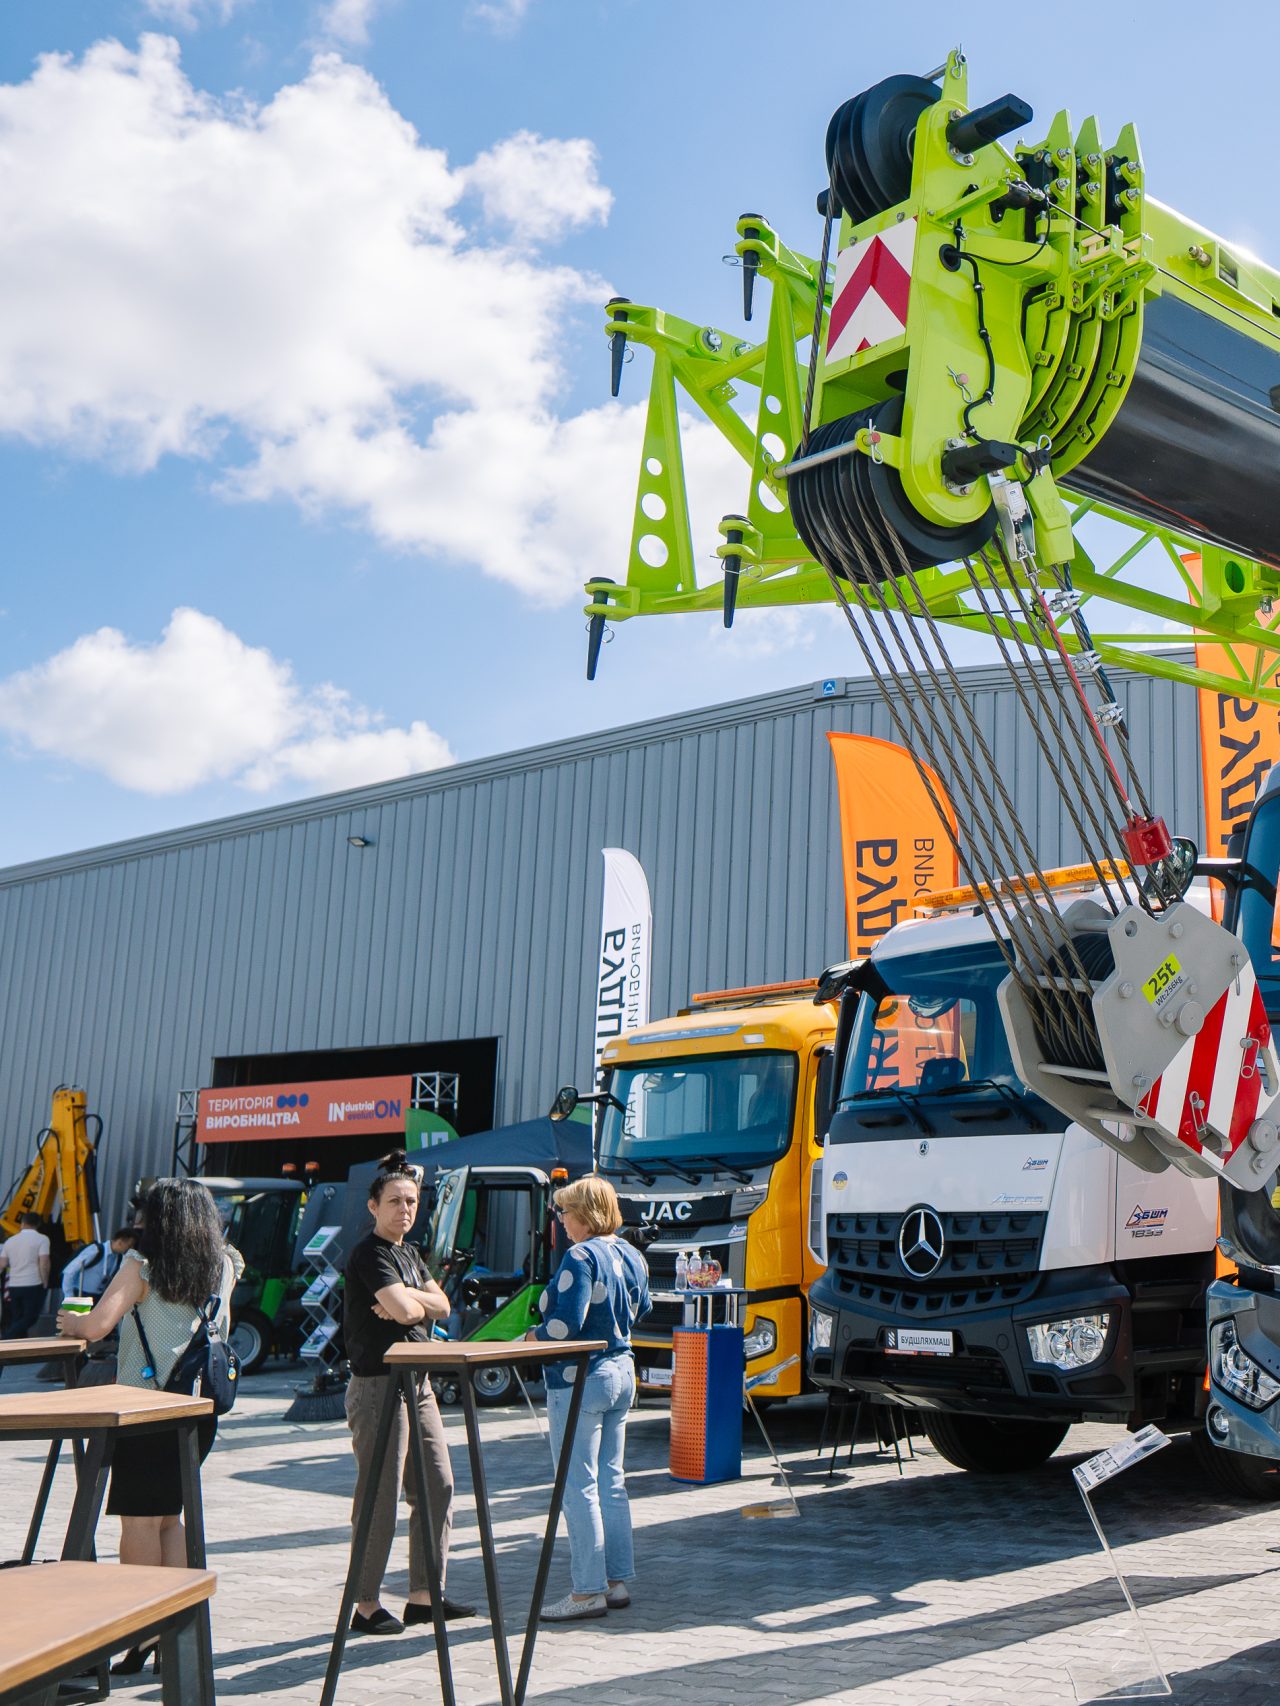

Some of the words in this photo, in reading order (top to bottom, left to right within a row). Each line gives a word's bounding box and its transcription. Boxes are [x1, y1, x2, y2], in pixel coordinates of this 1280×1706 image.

[1148, 962, 1176, 996] 25t
[208, 1096, 274, 1112] ТЕРИТОРІЯ
[206, 1111, 300, 1130] ВИРОБНИЦТВА
[641, 1202, 693, 1221] JAC
[900, 1336, 951, 1347] БУДШЛЯХМАШ
